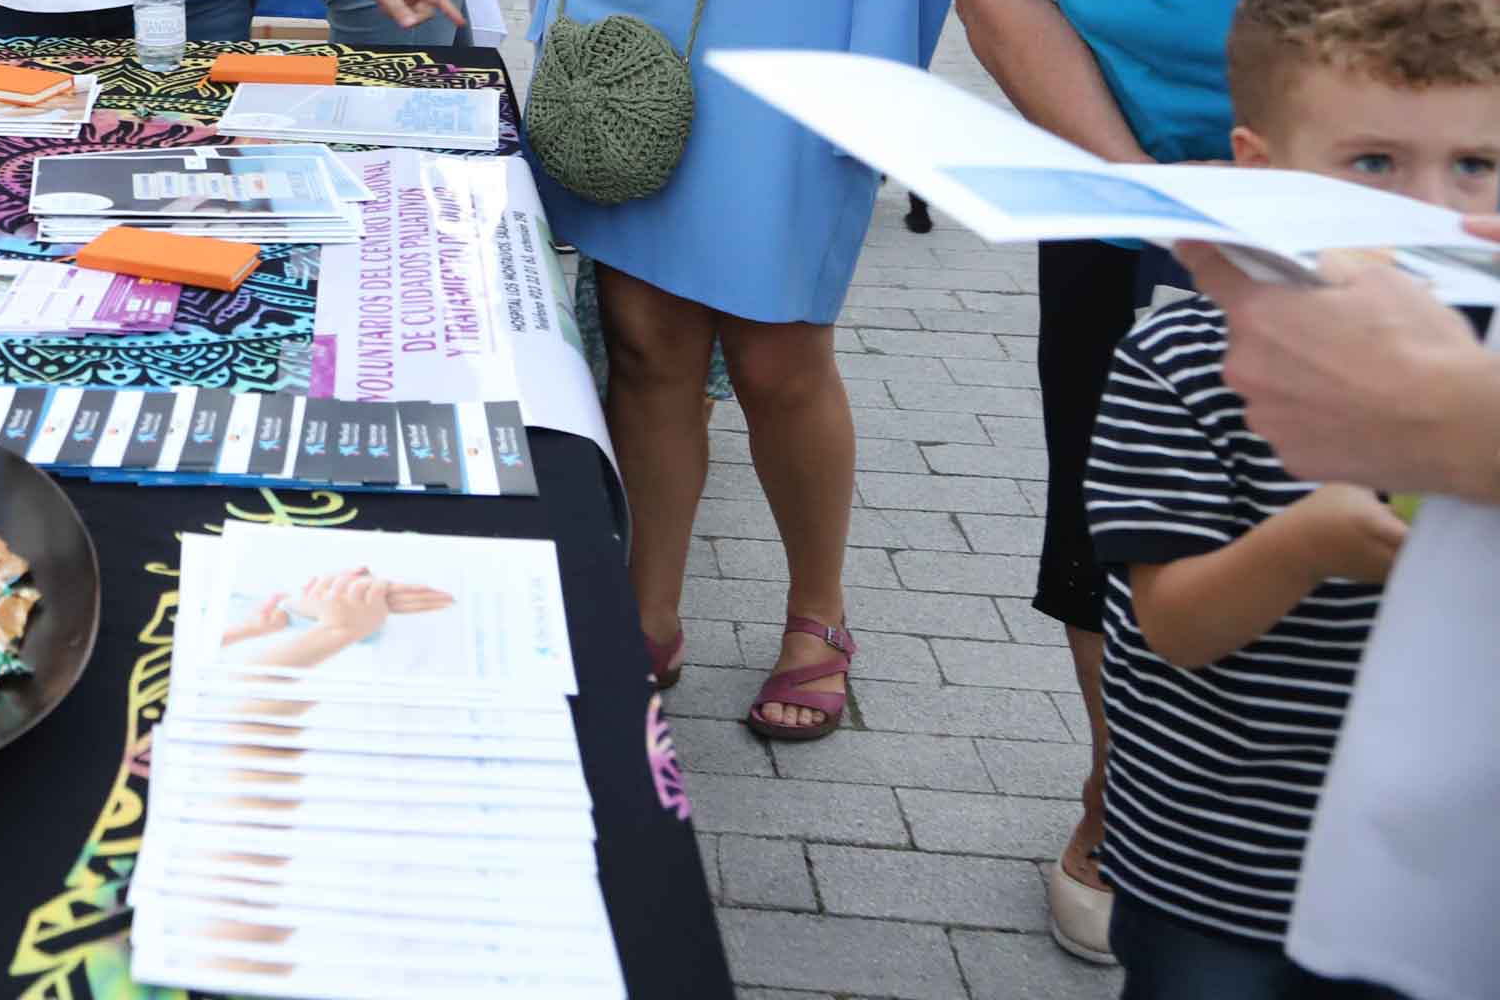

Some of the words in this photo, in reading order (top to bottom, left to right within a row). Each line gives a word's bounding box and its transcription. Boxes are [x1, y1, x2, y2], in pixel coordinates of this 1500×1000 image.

[398, 186, 429, 249] PALIATIVOS
[360, 215, 392, 262] CENTRO
[360, 265, 392, 290] DEL
[399, 252, 435, 326] CUIDADOS
[504, 282, 521, 297] LOS
[507, 299, 527, 332] HOSPITAL
[356, 295, 394, 402] VOLUNTARIOS
[401, 331, 436, 352] DE
[445, 346, 482, 358] Y
